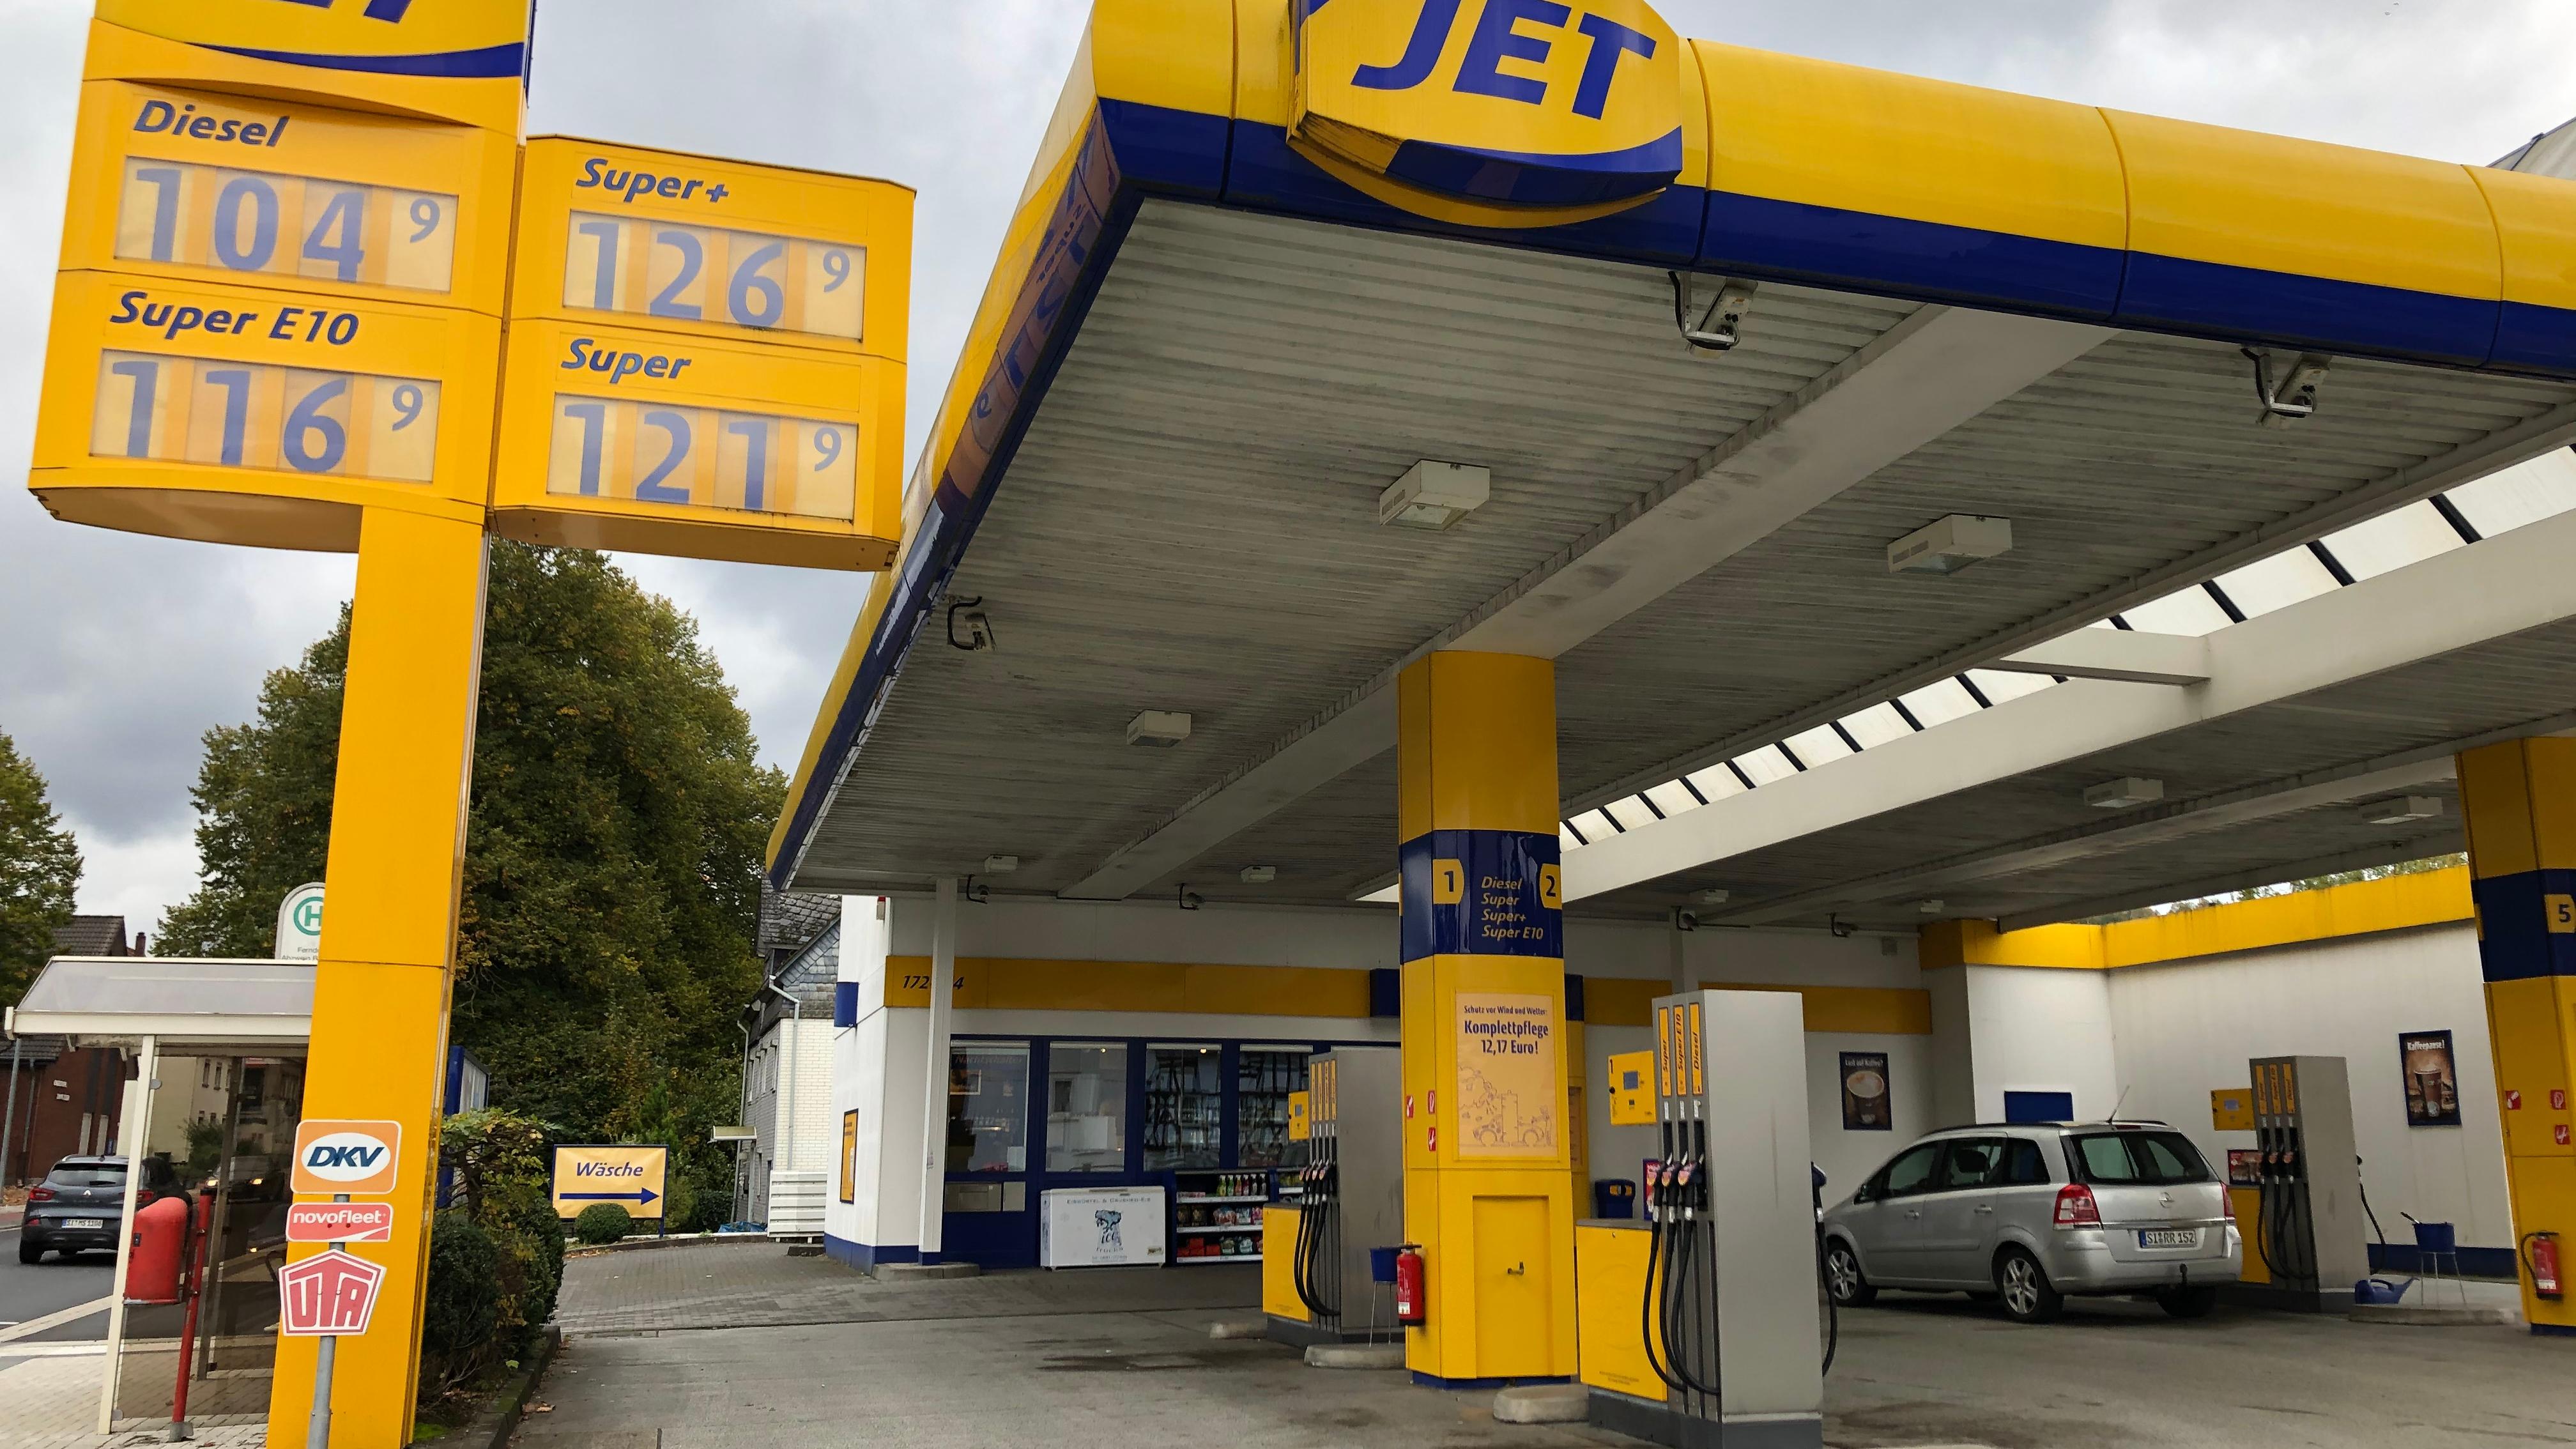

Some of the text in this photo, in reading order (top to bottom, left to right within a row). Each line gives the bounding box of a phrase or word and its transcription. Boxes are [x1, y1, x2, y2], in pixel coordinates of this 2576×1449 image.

[1350, 0, 1657, 120] JET
[133, 100, 290, 148] Diesel
[576, 158, 730, 203] Super+
[110, 291, 360, 345] Super E10
[561, 337, 691, 384] Super
[1444, 871, 1454, 892] 1
[1481, 876, 1522, 890] Diesel
[1545, 875, 1556, 898] 2
[1481, 893, 1520, 908] Super
[1481, 908, 1526, 925] Super+
[2559, 904, 2572, 923] 5
[1482, 925, 1544, 941] Super E10
[1464, 1005, 1484, 1013] Schutz
[1464, 1020, 1549, 1038] Komplettpflege
[1481, 1039, 1538, 1055] 12,17 Euro!
[307, 1146, 385, 1167] DKV
[576, 1162, 643, 1177] Wäsche
[293, 1210, 382, 1225] novofleet
[289, 1255, 374, 1327] UTA
